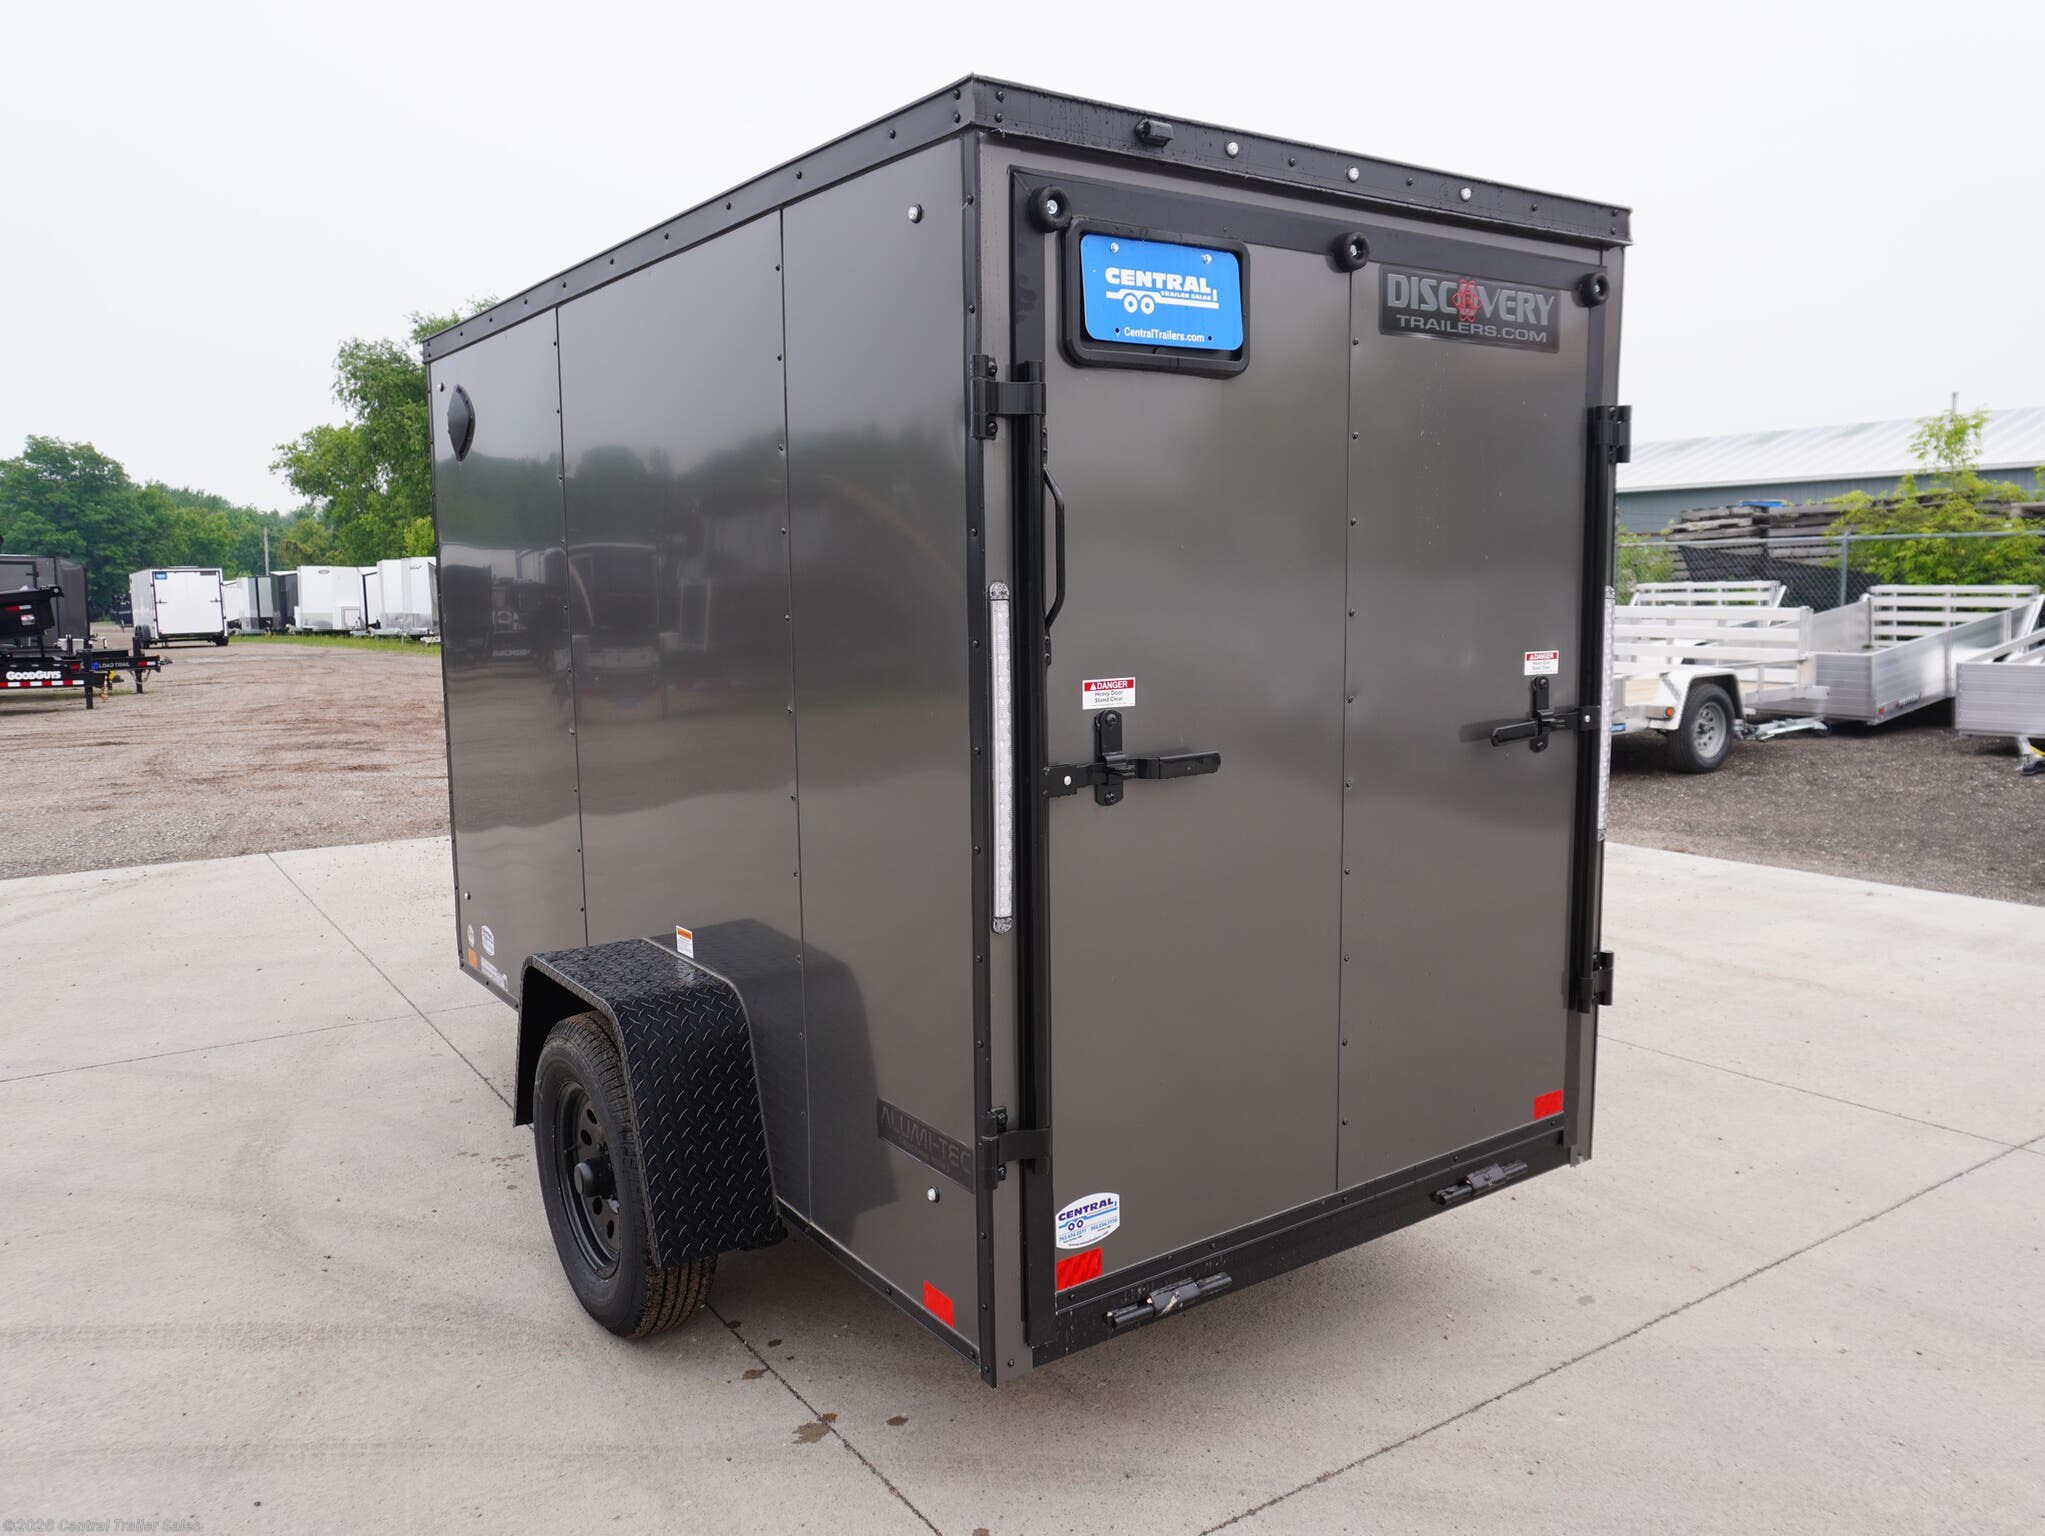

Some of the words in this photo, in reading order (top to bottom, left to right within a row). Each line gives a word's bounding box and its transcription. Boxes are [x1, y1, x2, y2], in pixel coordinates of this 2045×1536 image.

[1105, 267, 1211, 294] CENTRAL
[1161, 290, 1190, 299] TRAILER
[1190, 293, 1212, 301] SALES
[1124, 326, 1205, 343] CentralTrailers.com
[1396, 314, 1548, 343] TRAILERS.COM
[1097, 680, 1128, 690] DANGER
[1058, 1198, 1114, 1221] CENTRAL
